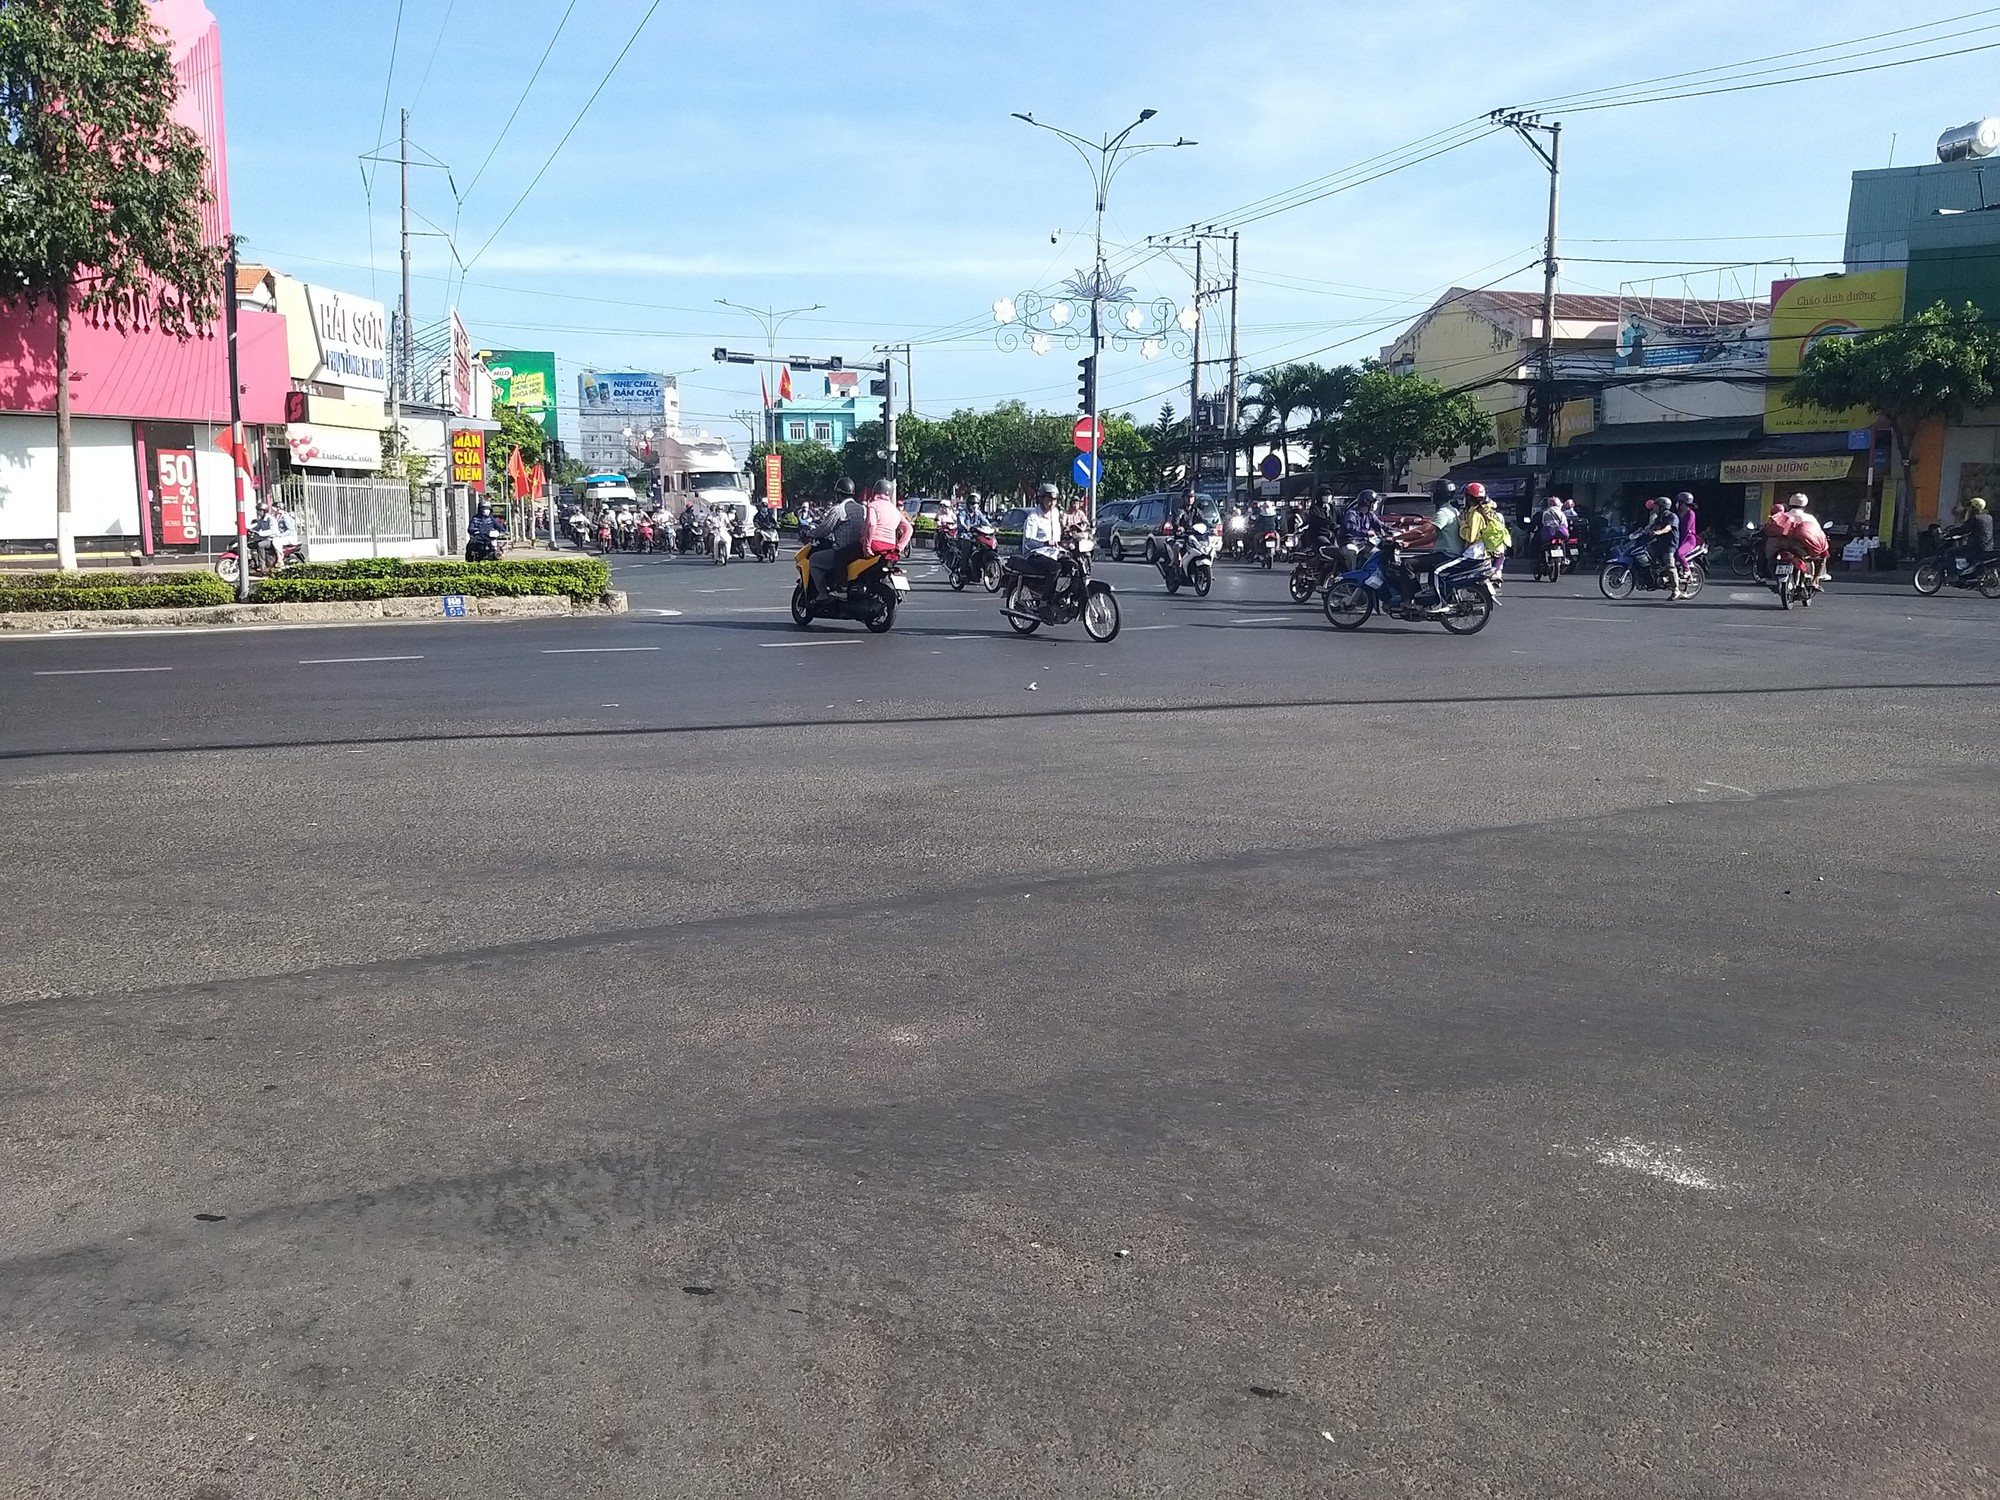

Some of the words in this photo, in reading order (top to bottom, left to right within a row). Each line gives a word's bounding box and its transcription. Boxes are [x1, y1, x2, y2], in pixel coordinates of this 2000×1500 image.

[633, 380, 658, 388] CHILL
[453, 432, 481, 448] MÀN
[454, 448, 481, 465] CỬA
[159, 454, 193, 487] 50
